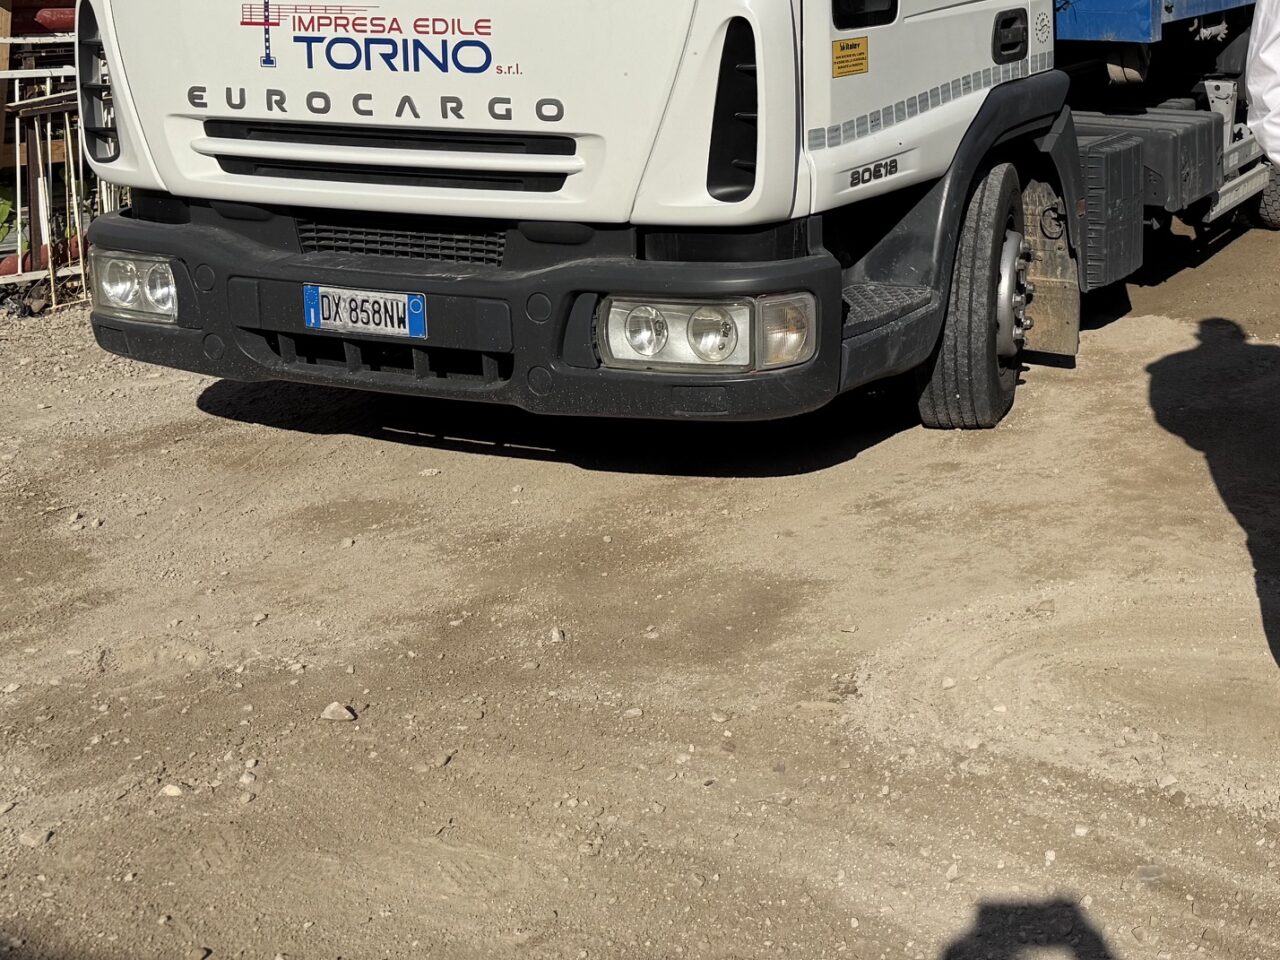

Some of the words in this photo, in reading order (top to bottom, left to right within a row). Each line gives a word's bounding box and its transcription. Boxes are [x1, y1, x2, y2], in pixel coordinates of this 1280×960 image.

[292, 15, 404, 34] IMPRESA
[413, 17, 493, 36] EDILE
[293, 35, 493, 74] TORINO
[495, 62, 523, 76] s.r.l.
[187, 85, 565, 123] EUROCARGO
[850, 158, 898, 188] 80E18
[321, 294, 342, 322] DX
[348, 297, 407, 329] 858NW
